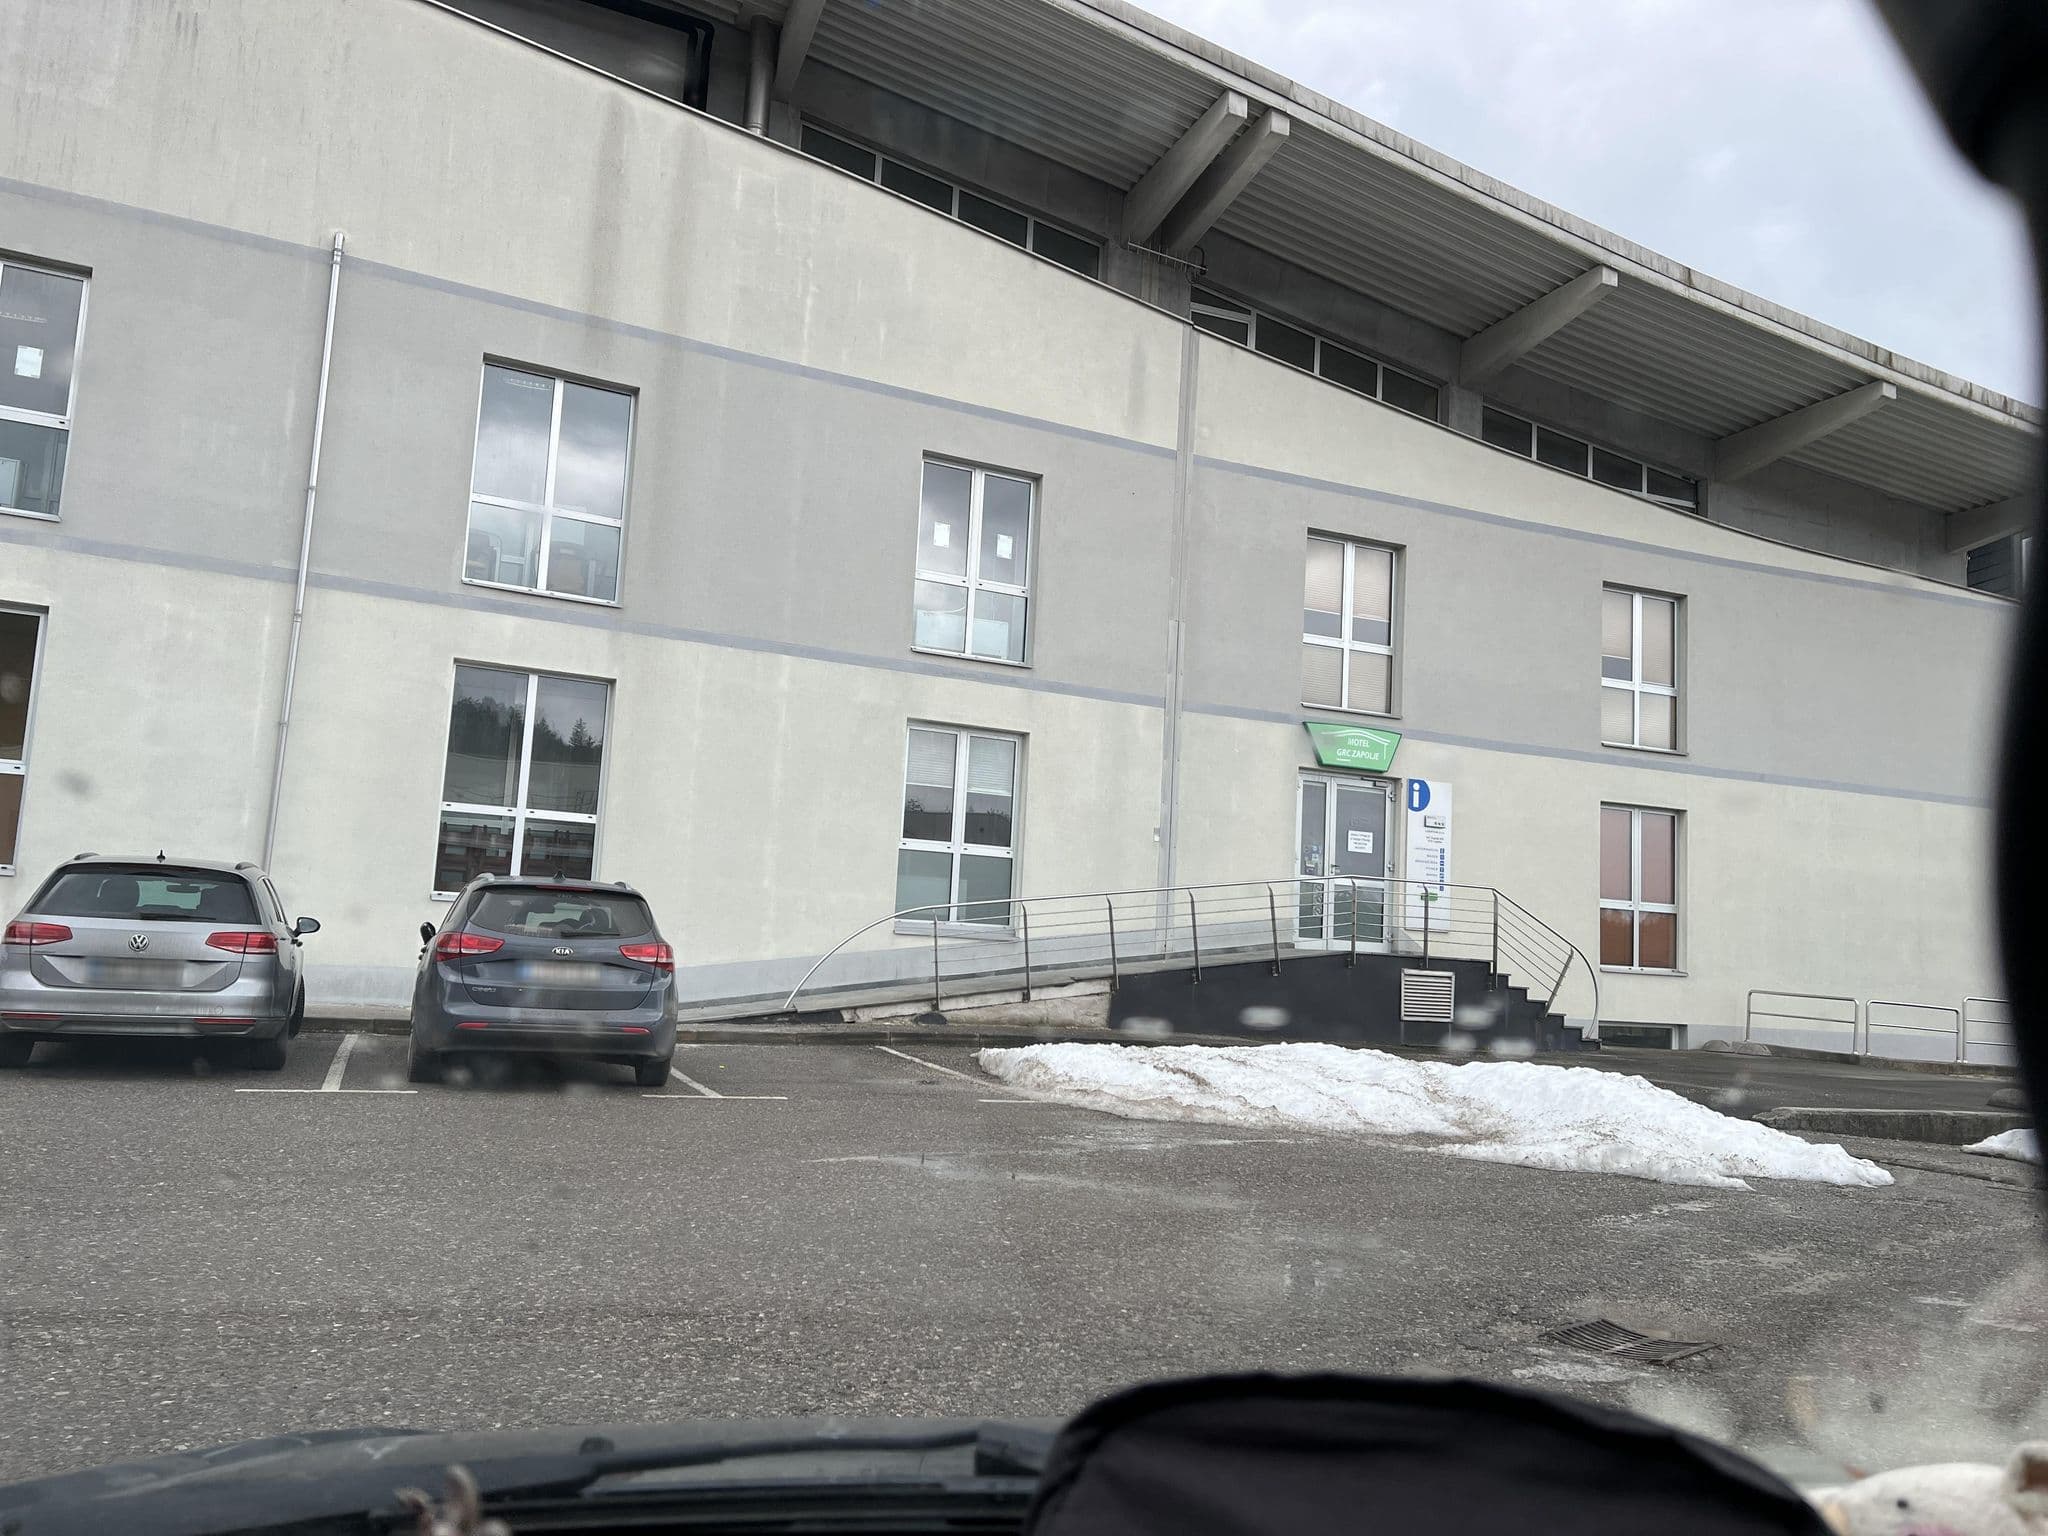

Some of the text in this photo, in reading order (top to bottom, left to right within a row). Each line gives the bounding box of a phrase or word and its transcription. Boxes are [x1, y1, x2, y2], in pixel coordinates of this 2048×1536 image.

[1347, 738, 1370, 747] MOTEL
[1336, 748, 1380, 760] GRC ZAPOLJE
[128, 933, 150, 952] VW
[554, 947, 571, 955] KIA
